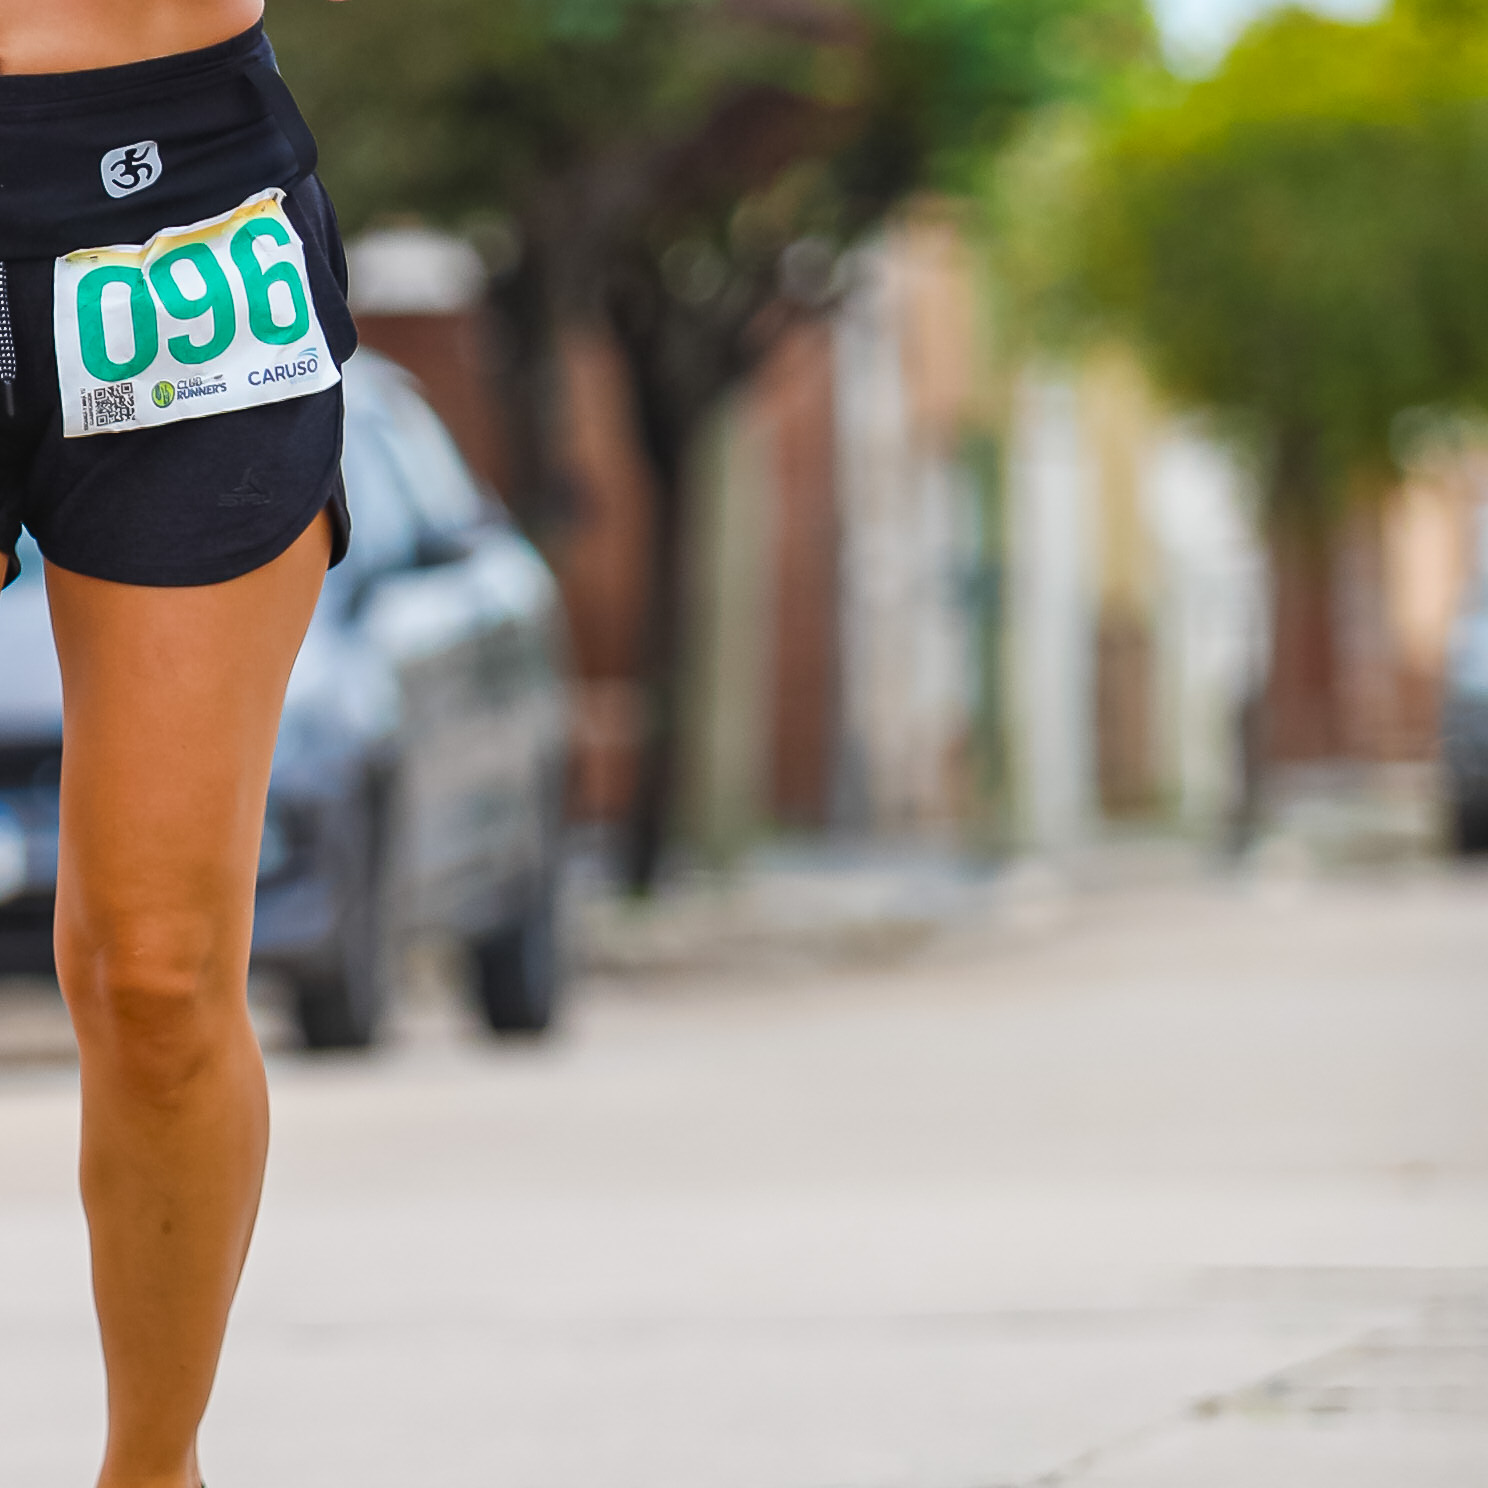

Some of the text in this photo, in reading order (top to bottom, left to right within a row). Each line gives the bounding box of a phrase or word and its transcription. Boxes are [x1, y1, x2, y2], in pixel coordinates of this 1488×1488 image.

[77, 217, 310, 382] 096
[247, 358, 318, 386] CARUSO
[177, 382, 227, 400] RUNNER'S
